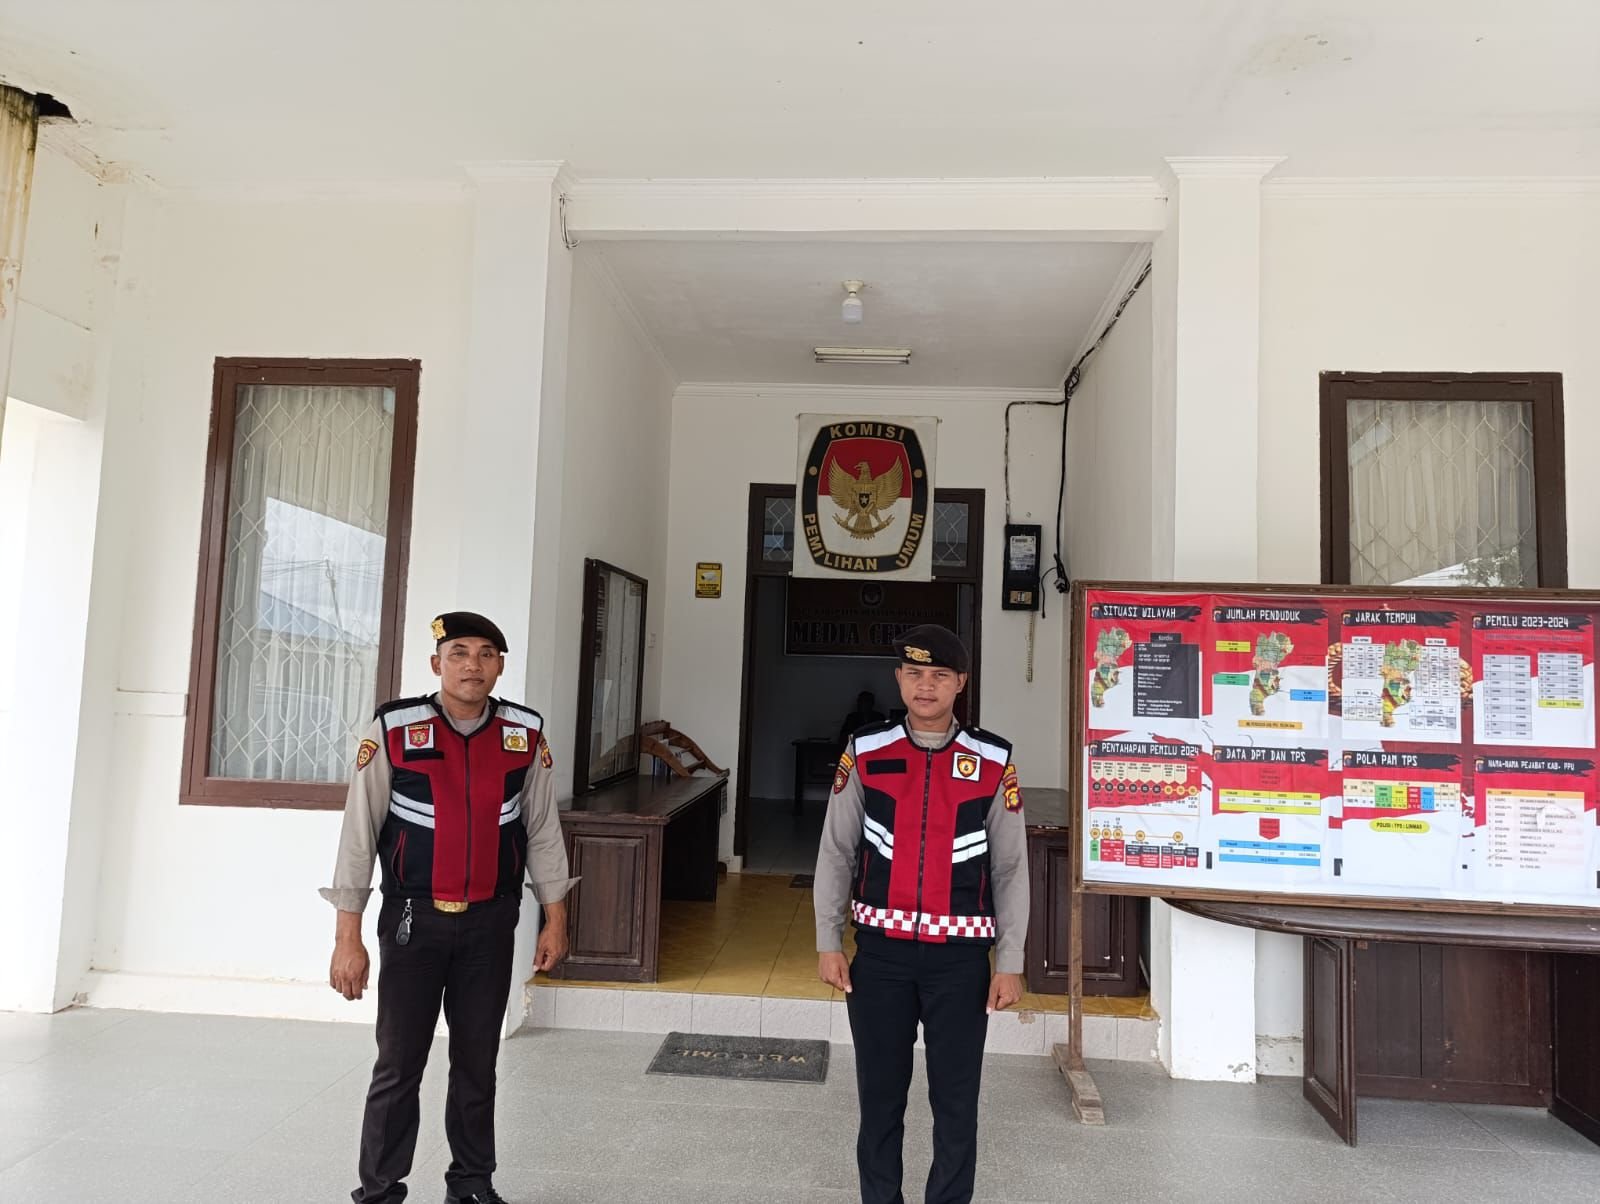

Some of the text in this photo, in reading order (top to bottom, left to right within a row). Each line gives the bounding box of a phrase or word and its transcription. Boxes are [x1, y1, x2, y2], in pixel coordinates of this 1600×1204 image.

[829, 423, 905, 441] KOMISI
[804, 513, 924, 571] PEMILIHAN UMUM
[1103, 605, 1177, 618] SITUASI WILAYAH
[1226, 608, 1301, 621] JUMLAH PENDUDUK
[1355, 612, 1416, 624] JARAK TEMPUH
[1485, 615, 1569, 628] PEMILU 2023-2024
[792, 620, 859, 645] MEDIA
[1101, 743, 1199, 756] PENTAHAPAN PEMILU 2024
[1226, 748, 1306, 762] DATA DPT DAN TPS
[1356, 753, 1418, 767] POLA PAM TPS
[1488, 759, 1519, 768] NAMA-NAMA
[1521, 761, 1545, 769] PEJABAT
[1547, 762, 1561, 770] KAB.
[672, 1047, 806, 1064] WELCOME
